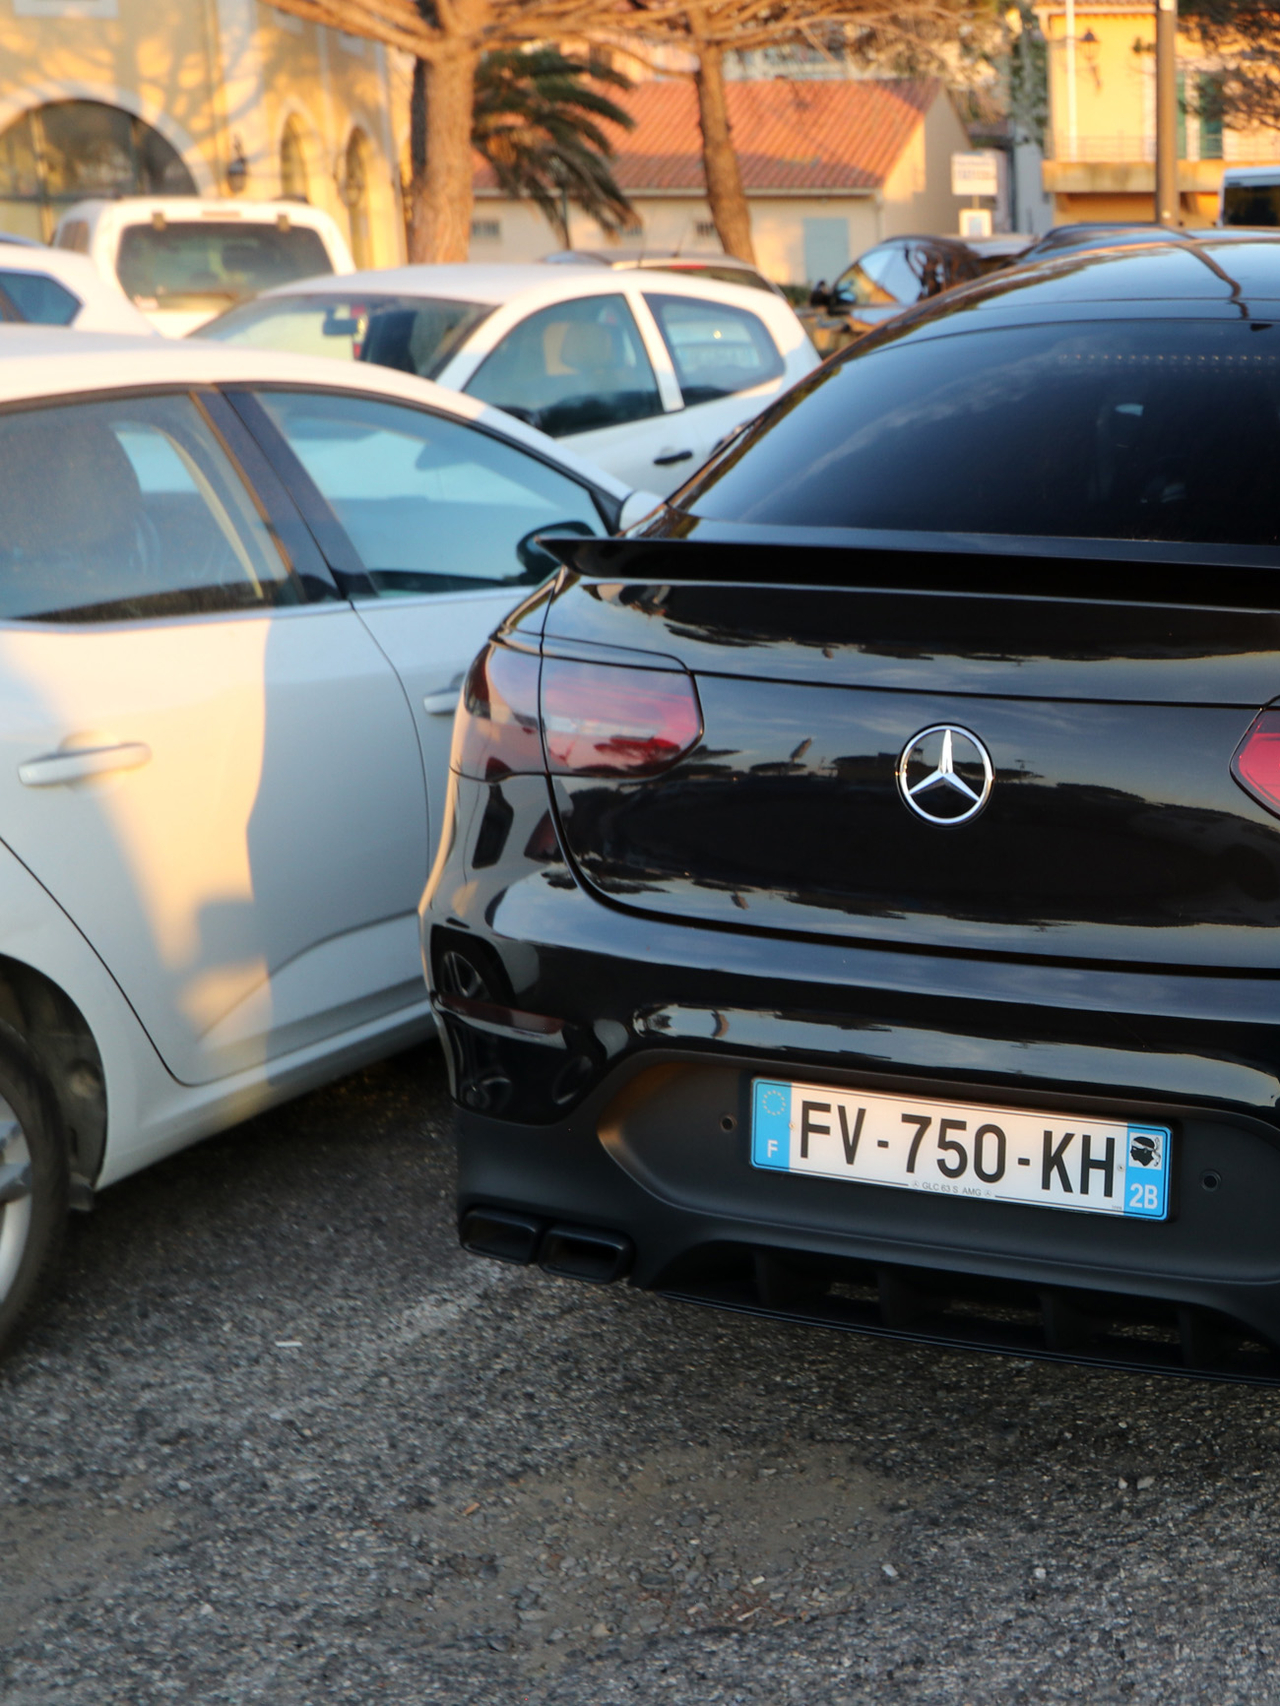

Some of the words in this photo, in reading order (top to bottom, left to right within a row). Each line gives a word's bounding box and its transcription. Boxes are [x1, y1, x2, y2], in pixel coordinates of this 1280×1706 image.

[766, 1139, 778, 1159] F
[800, 1100, 1116, 1198] FV-750-KH
[922, 1181, 939, 1191] GLC
[941, 1184, 951, 1193] 63
[952, 1186, 959, 1194] S
[962, 1187, 981, 1196] AMG
[1129, 1183, 1158, 1209] 2B
